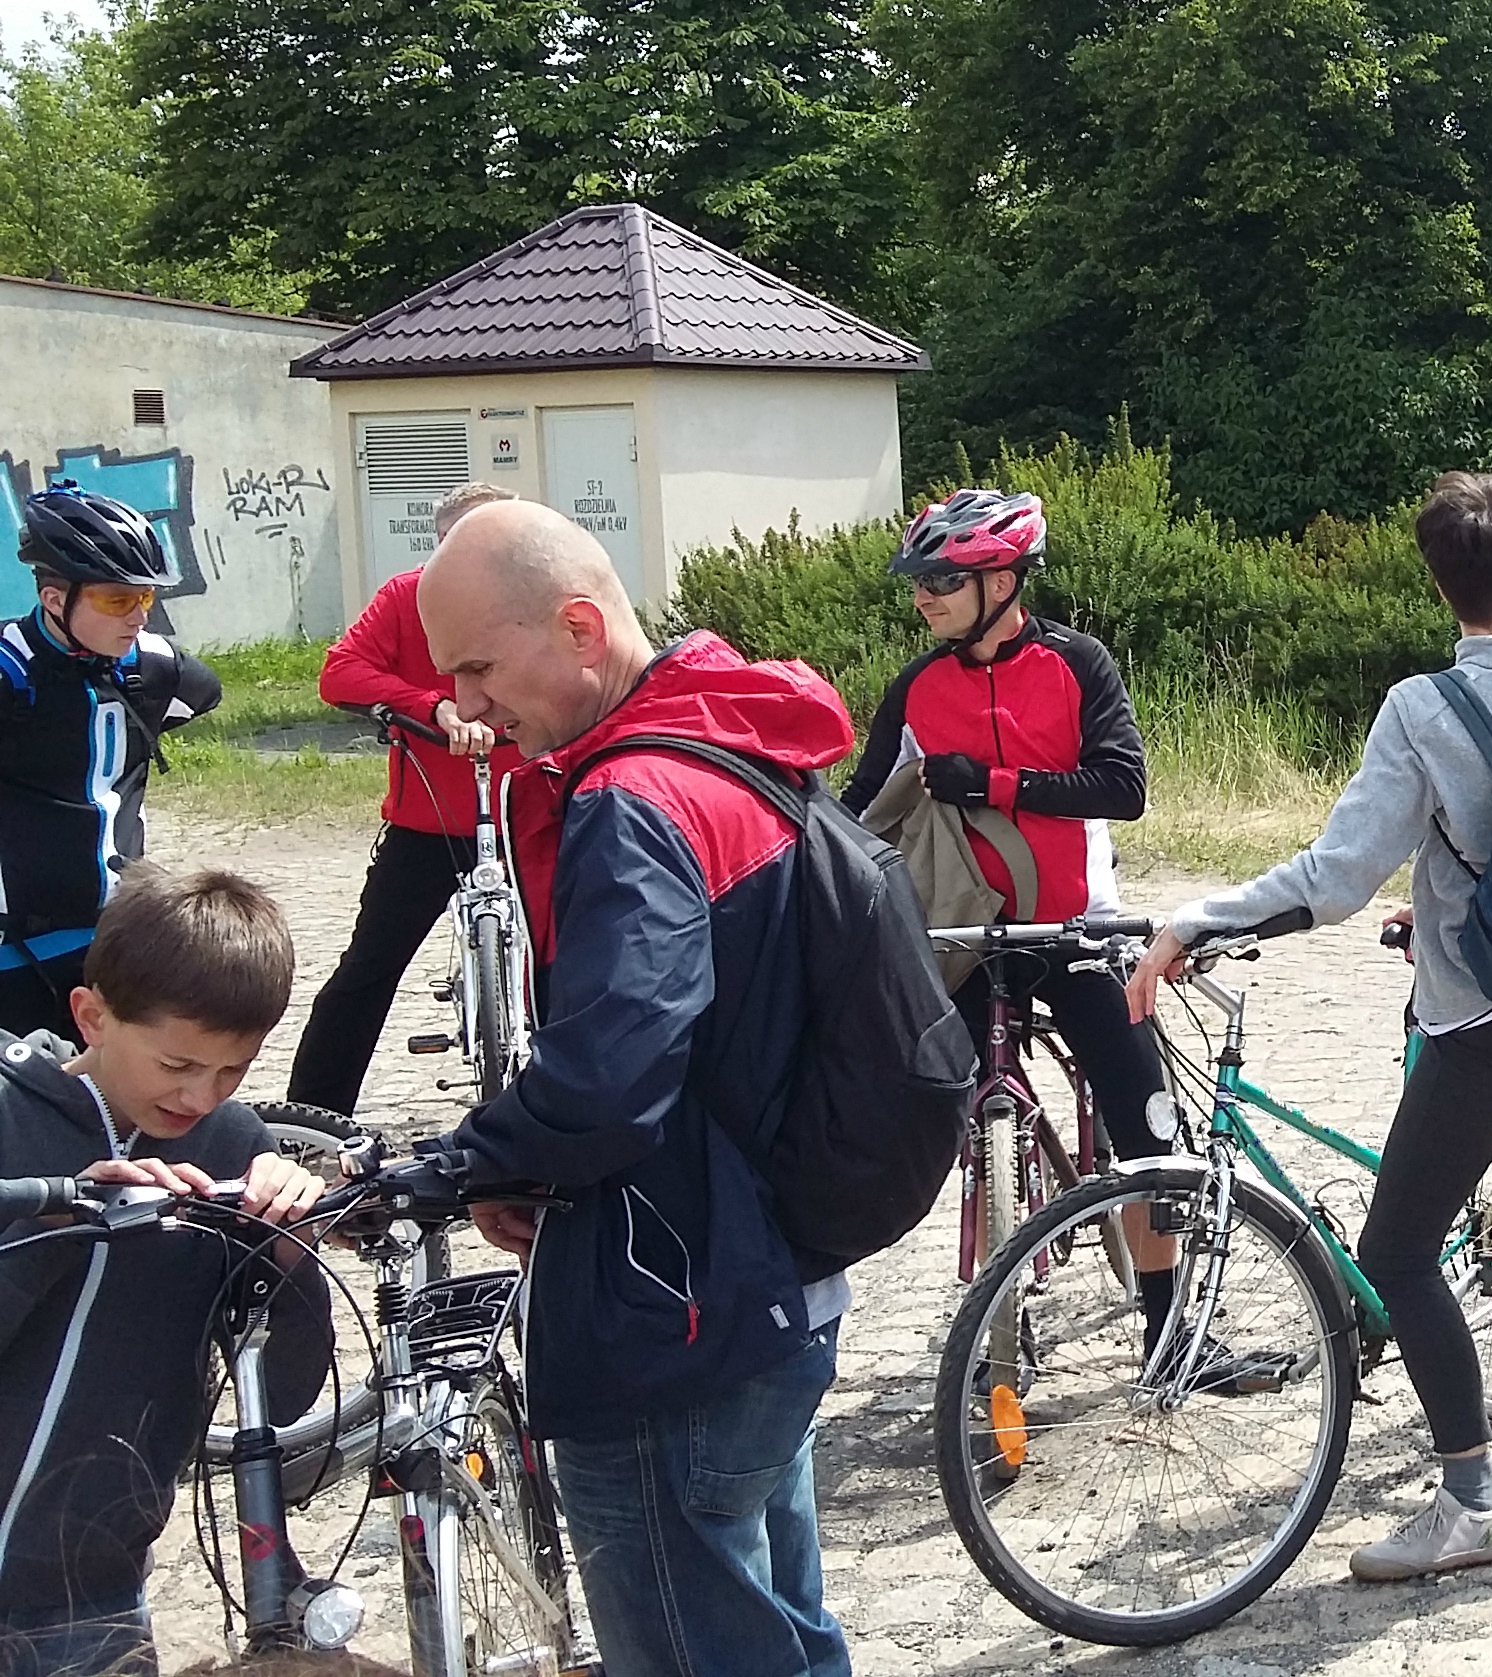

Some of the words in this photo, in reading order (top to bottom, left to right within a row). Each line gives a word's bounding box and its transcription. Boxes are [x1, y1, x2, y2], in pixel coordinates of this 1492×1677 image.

[225, 492, 305, 522] RAM
[407, 501, 434, 517] KOMORA
[574, 498, 617, 514] ROZDZIELNIA
[389, 518, 437, 534] TRANSFORMATO
